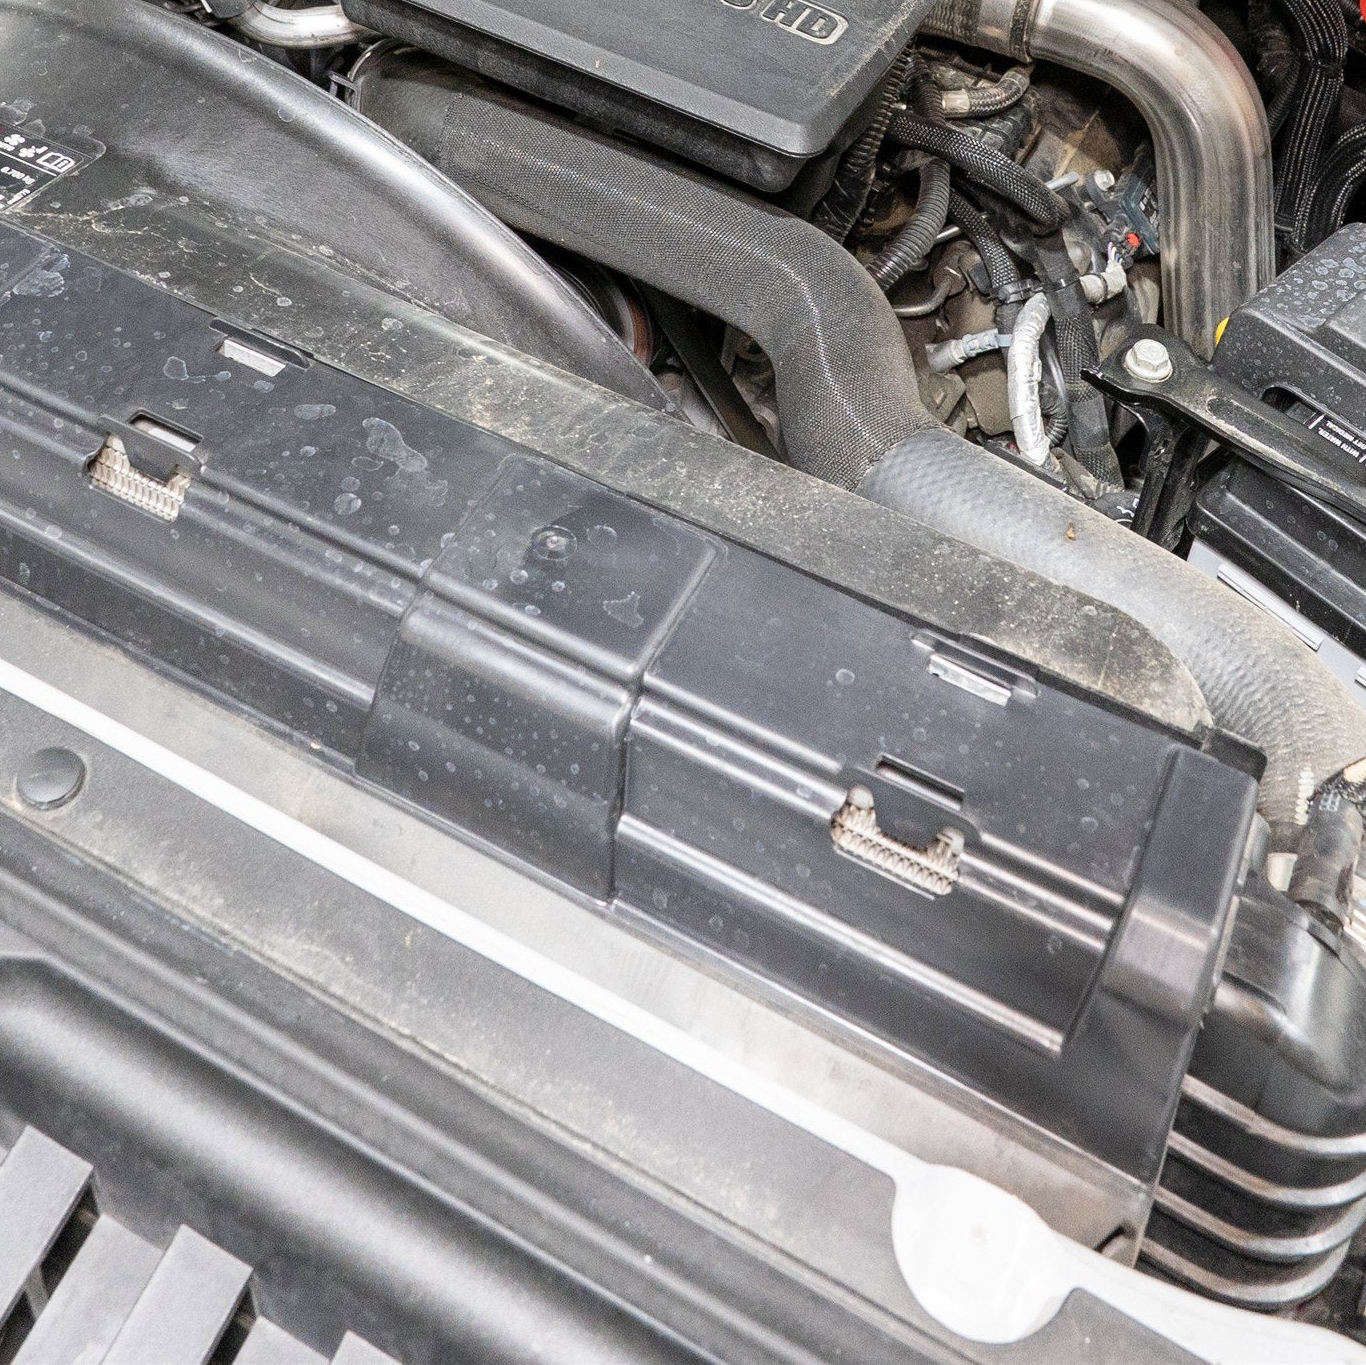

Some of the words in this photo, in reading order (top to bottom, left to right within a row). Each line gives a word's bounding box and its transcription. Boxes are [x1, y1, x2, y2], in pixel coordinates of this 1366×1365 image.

[1317, 427, 1342, 448] WATER.
[1326, 420, 1357, 443] MEDICAL
[1340, 442, 1360, 459] WITH
